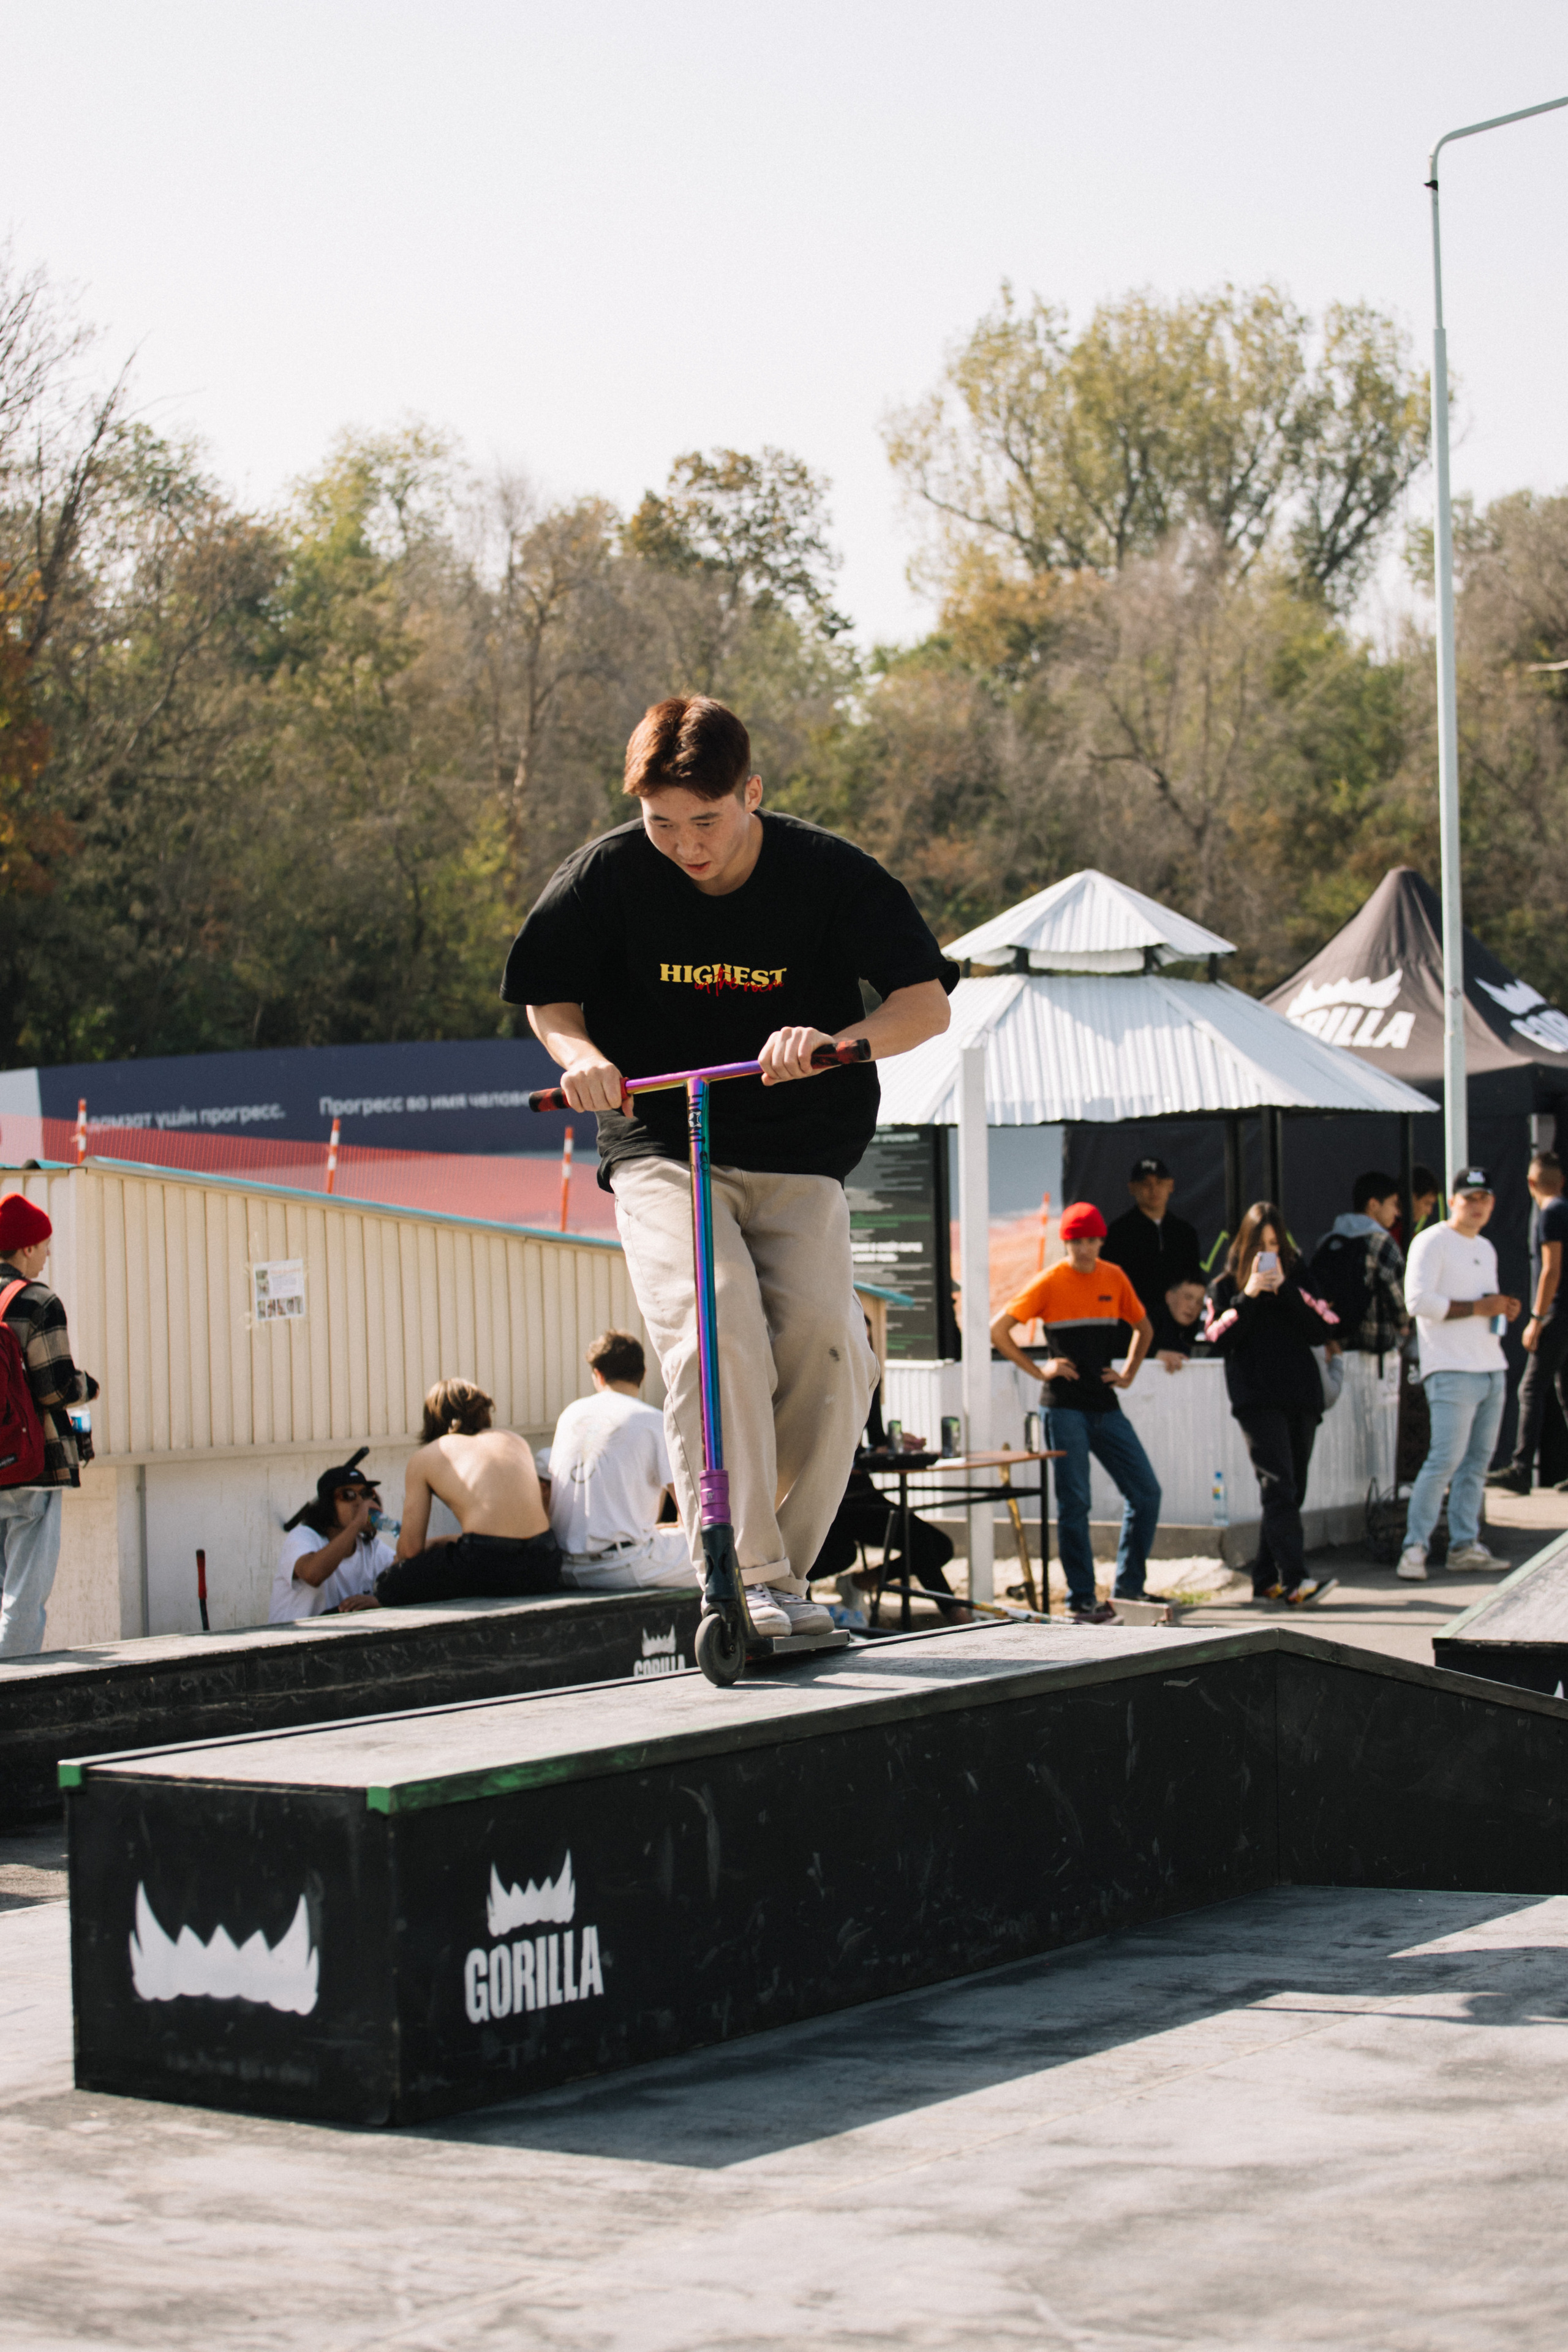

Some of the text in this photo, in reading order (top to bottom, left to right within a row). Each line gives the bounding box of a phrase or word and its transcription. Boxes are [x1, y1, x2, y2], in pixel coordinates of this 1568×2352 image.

[660, 963, 786, 987] HIGHEST
[1290, 1006, 1415, 1049] RILLA
[200, 1102, 286, 1128] прогресс.
[319, 1095, 403, 1118] Прогресс
[469, 1090, 530, 1109] челове
[464, 1924, 604, 2024] GORILLA
